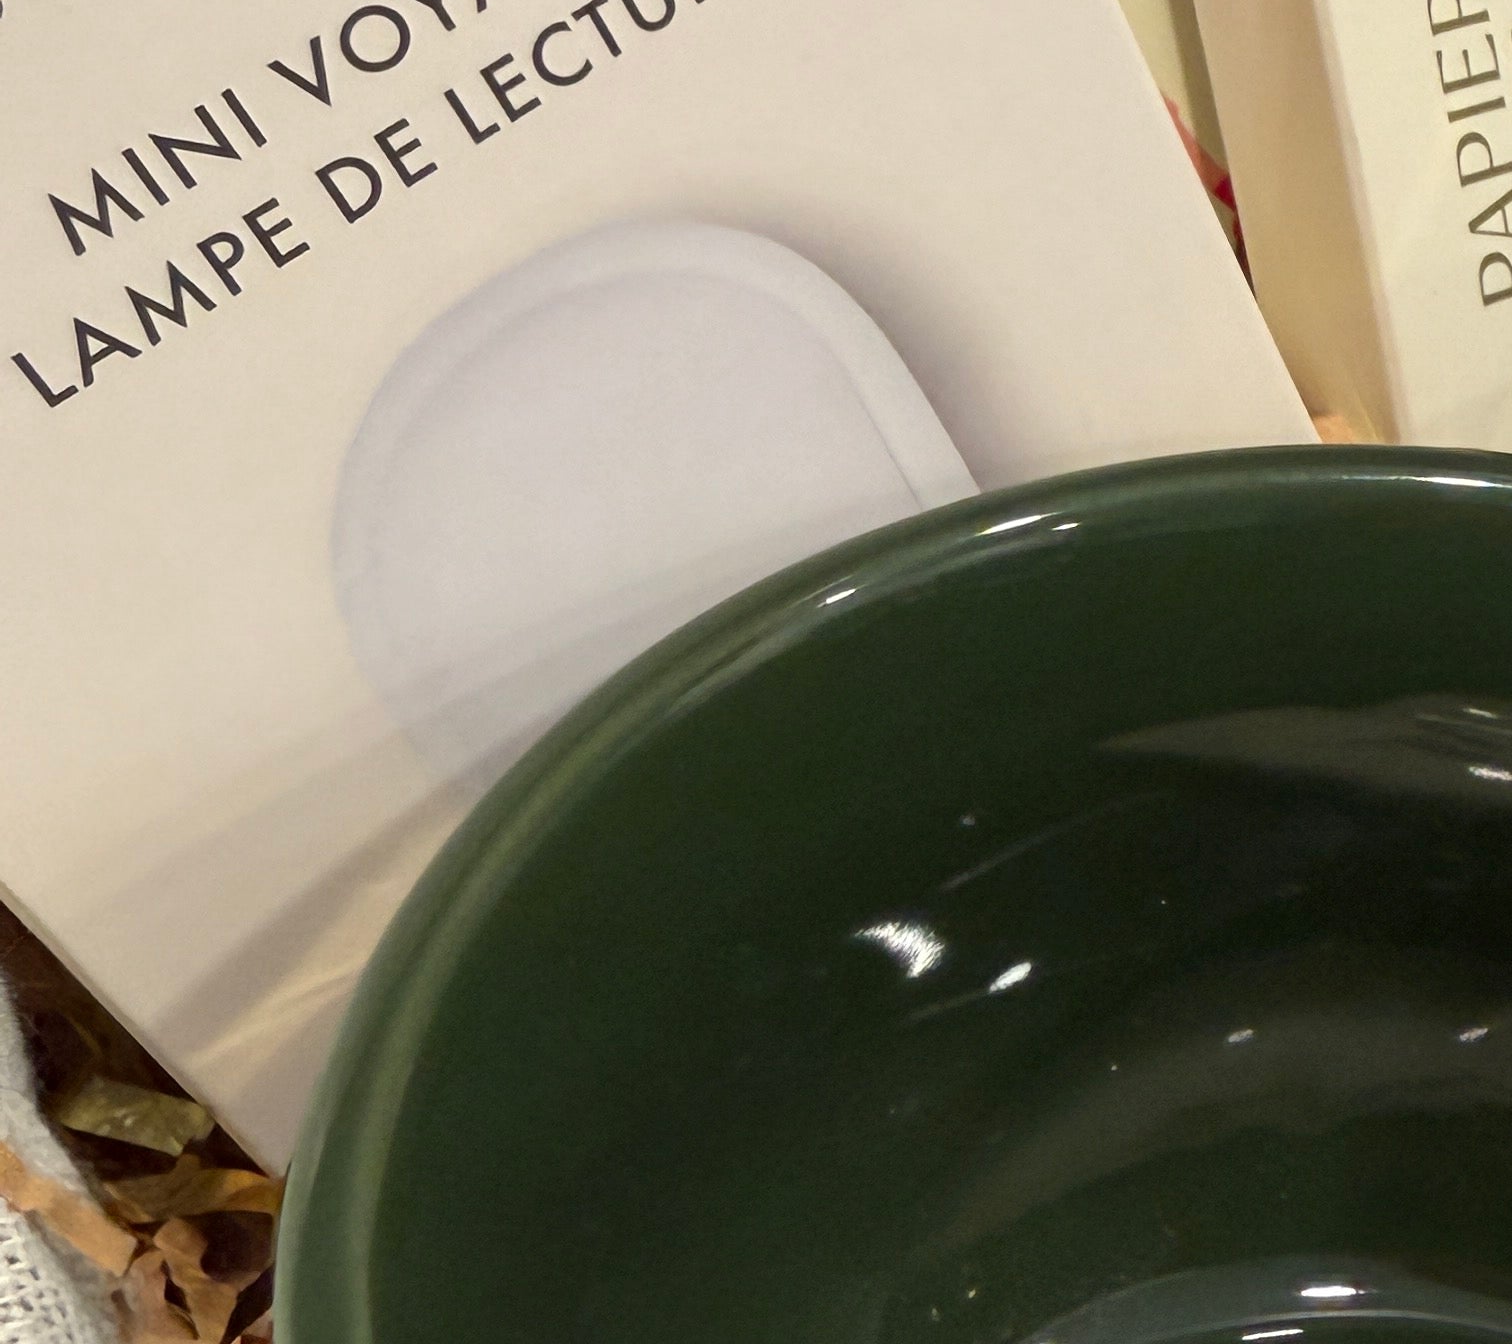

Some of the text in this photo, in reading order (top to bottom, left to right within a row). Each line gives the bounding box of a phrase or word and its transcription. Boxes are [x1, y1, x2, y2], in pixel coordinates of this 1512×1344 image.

[11, 197, 311, 408] LAMPE
[314, 116, 439, 224] DE
[47, 87, 269, 257] MINI
